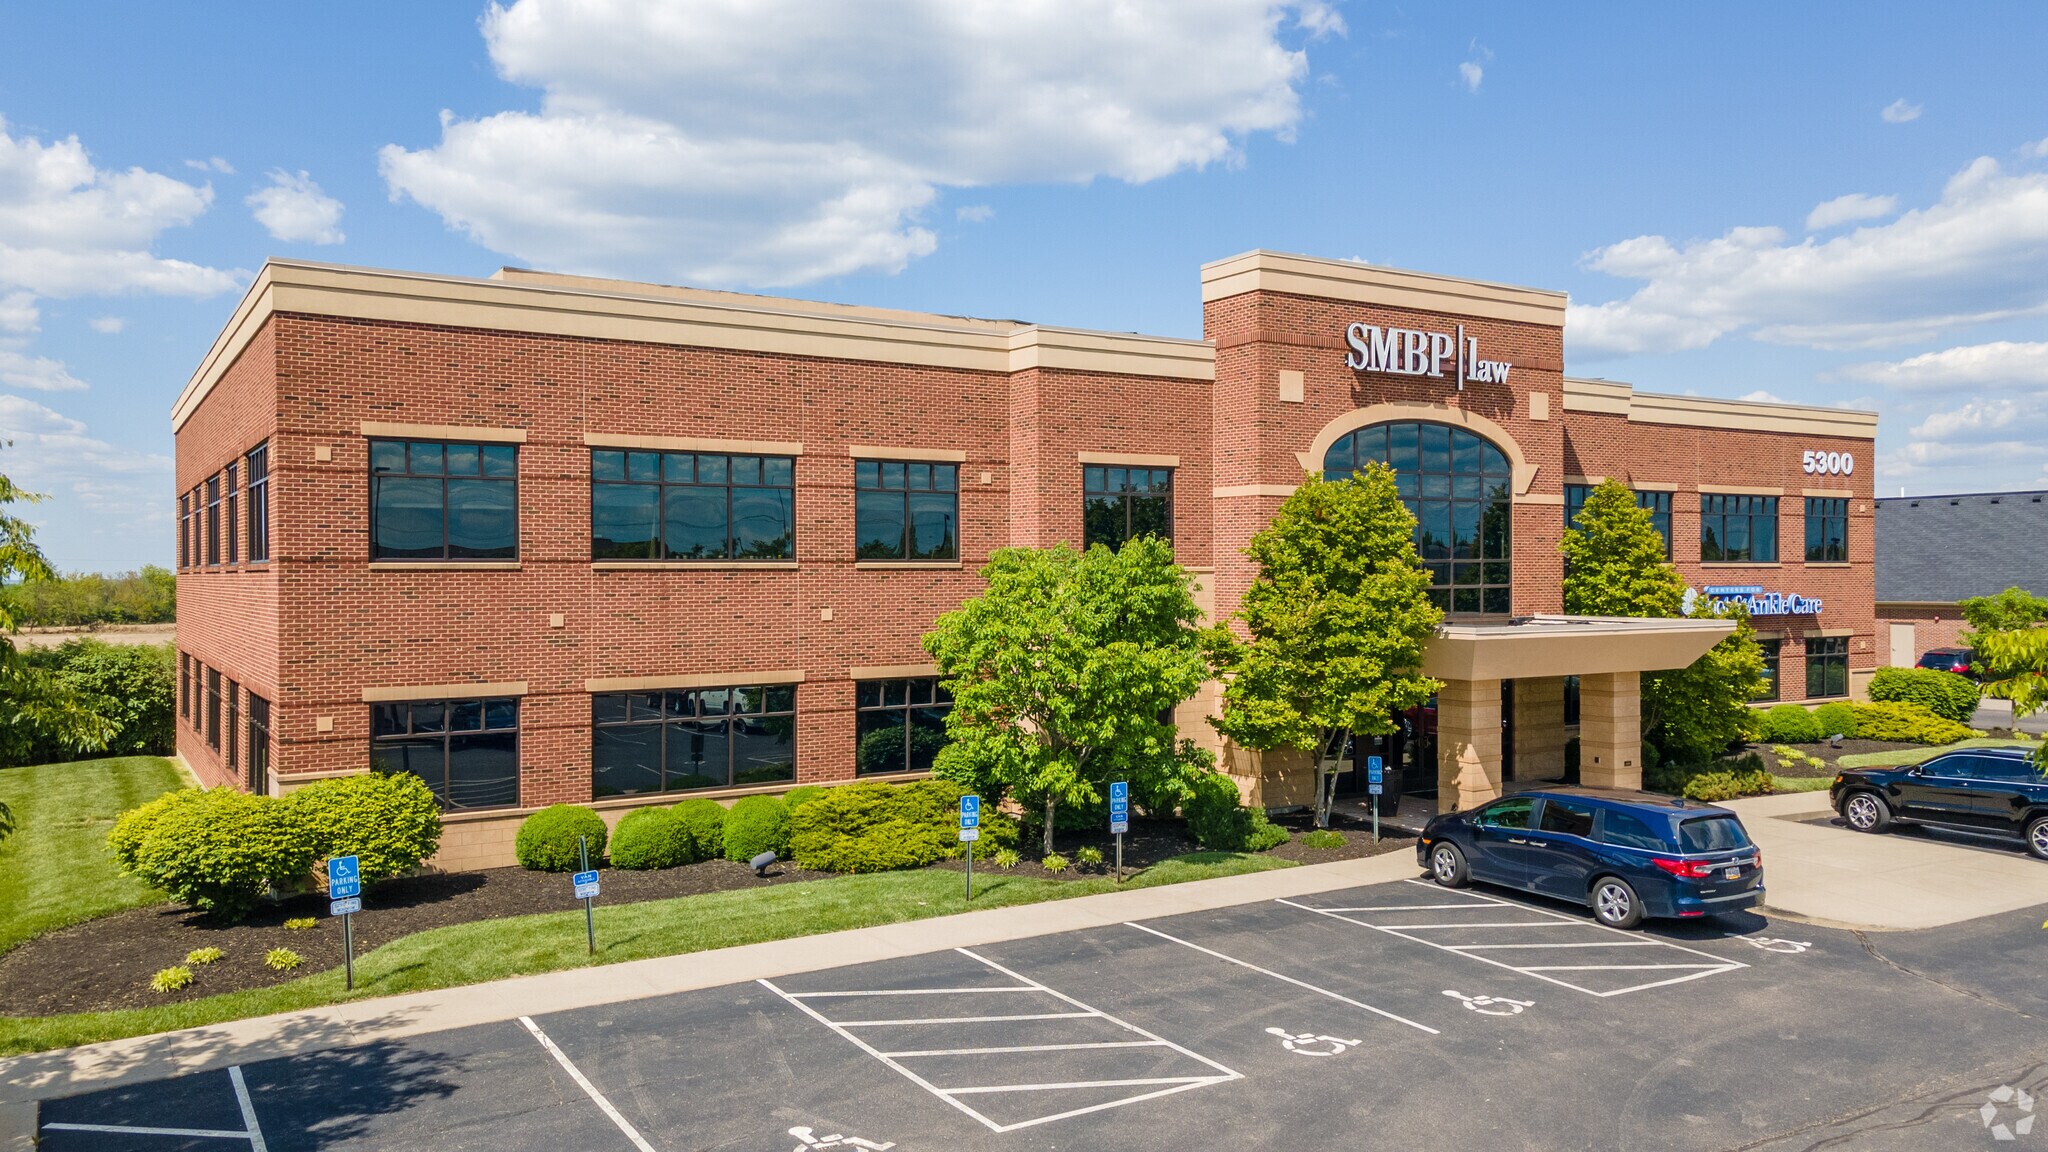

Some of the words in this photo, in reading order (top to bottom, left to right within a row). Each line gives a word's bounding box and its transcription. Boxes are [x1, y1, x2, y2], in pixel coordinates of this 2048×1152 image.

[1345, 321, 1454, 377] SMBP
[1466, 336, 1512, 384] law
[1802, 450, 1854, 475] 5300
[1749, 592, 1790, 615] Ankle
[1790, 594, 1823, 614] Care
[331, 875, 358, 887] PARKING
[336, 885, 353, 895] ONLY
